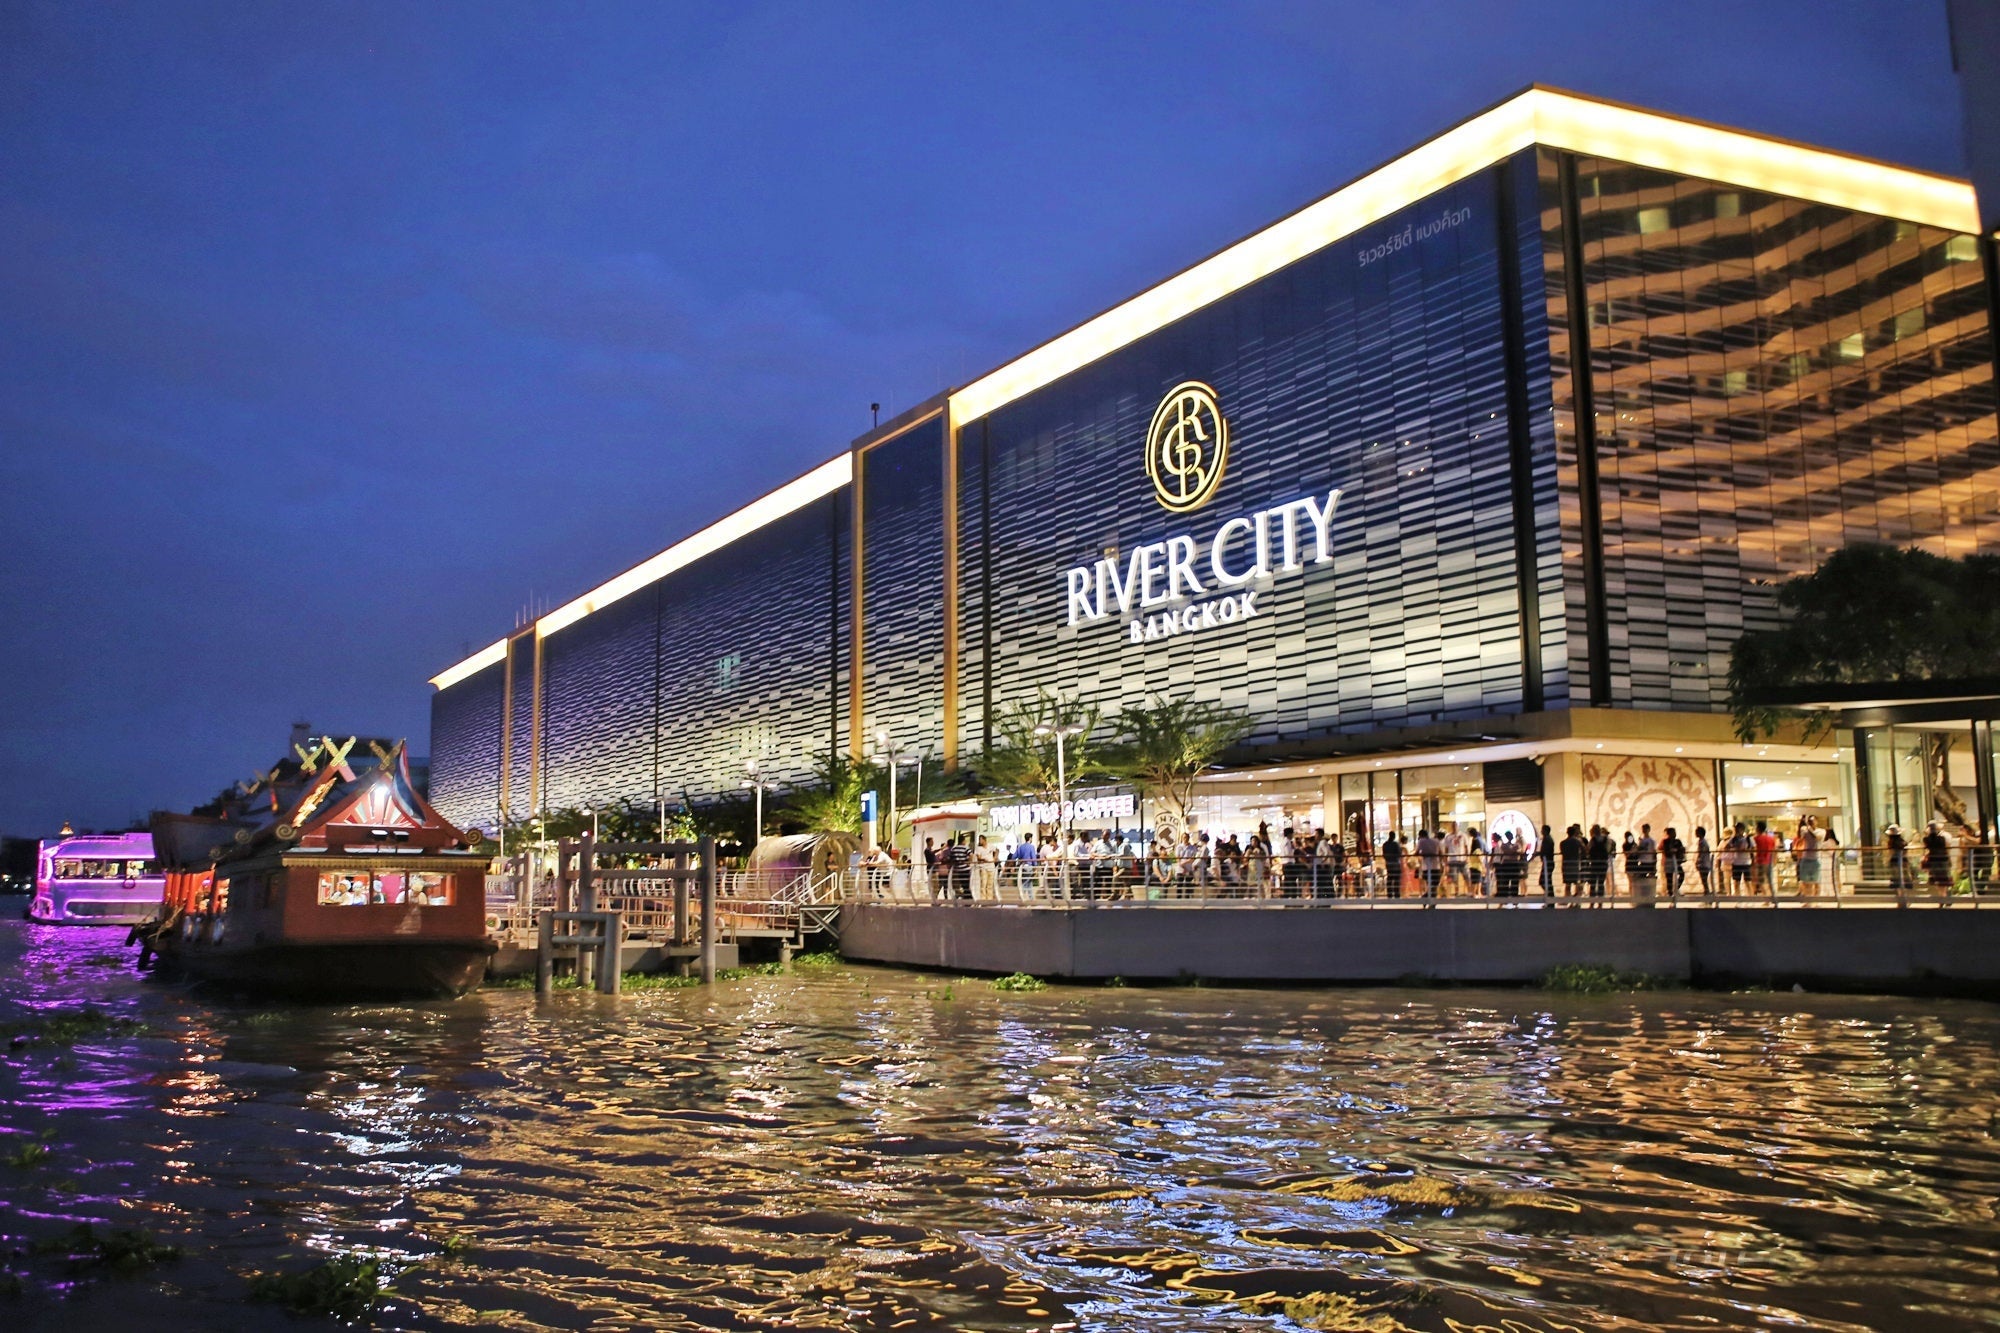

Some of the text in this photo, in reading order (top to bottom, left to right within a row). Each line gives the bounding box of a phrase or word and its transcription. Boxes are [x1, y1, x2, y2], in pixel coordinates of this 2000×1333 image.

[1415, 206, 1471, 242] แบงค็อก
[1066, 488, 1345, 626] RIVER CITY
[1129, 591, 1260, 643] BANGKOK
[1074, 794, 1135, 821] COFFEE
